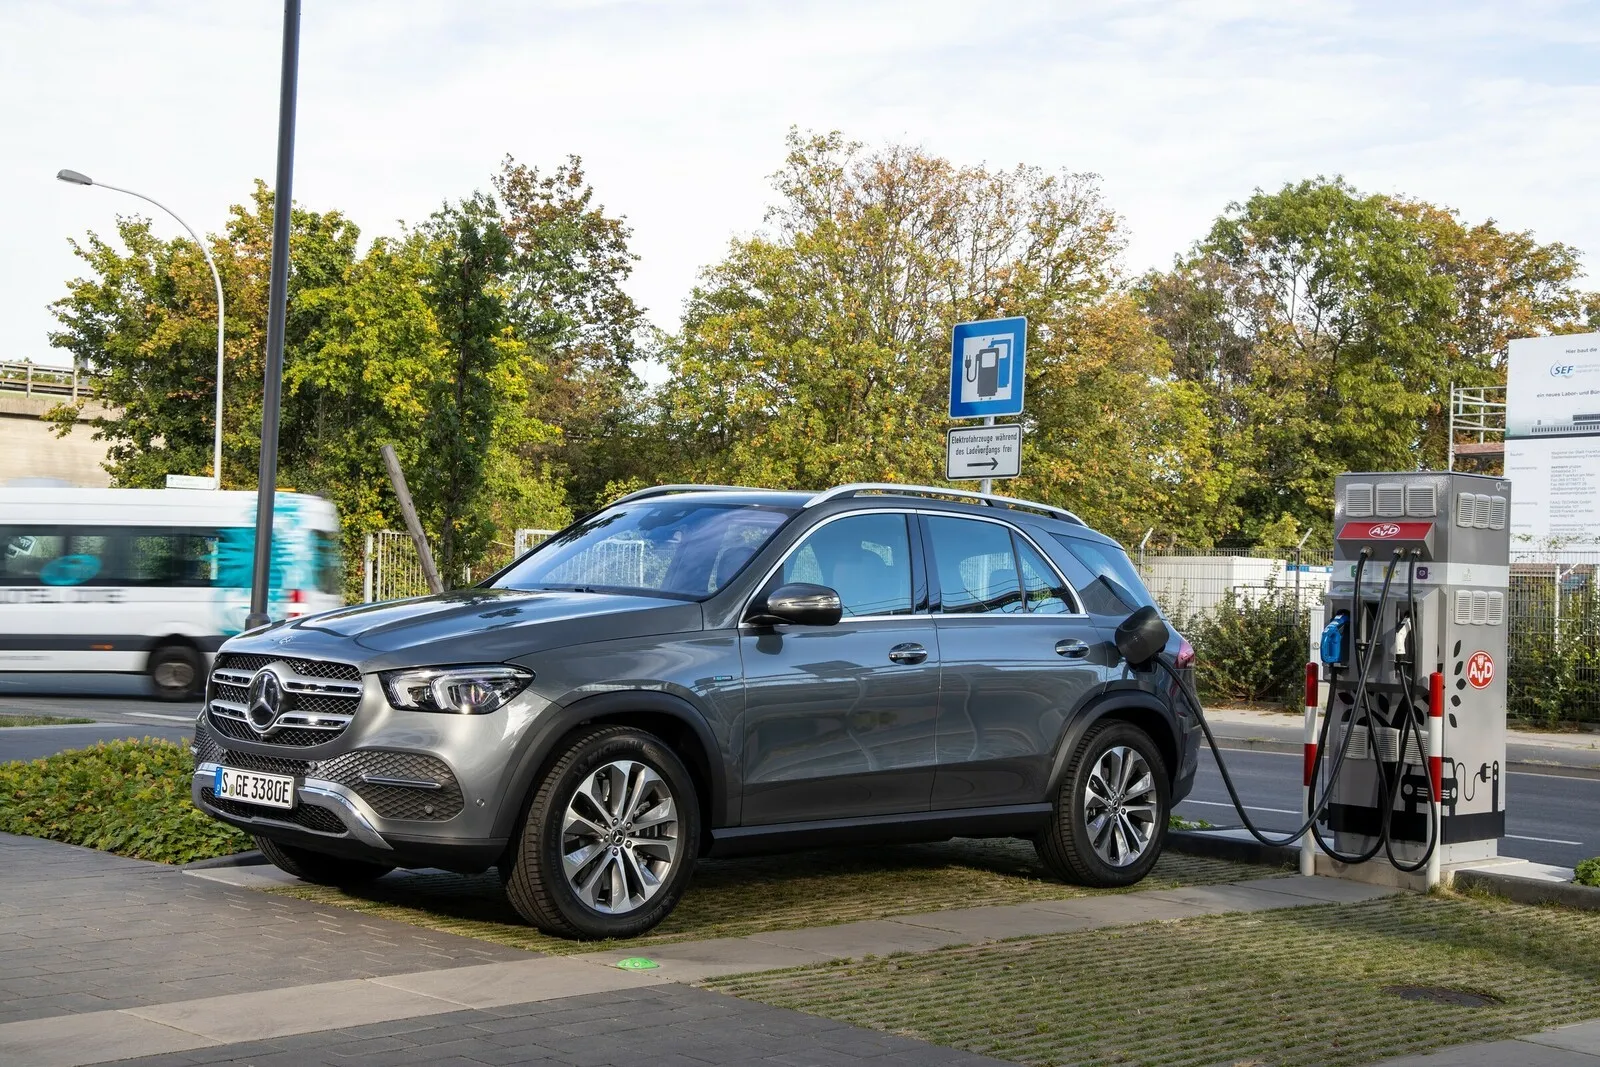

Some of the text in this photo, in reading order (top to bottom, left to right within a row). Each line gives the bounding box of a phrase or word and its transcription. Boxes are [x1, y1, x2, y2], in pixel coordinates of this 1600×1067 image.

[1554, 365, 1574, 375] SEF
[951, 433, 1018, 444] Elektrofahrzeuge während
[966, 446, 1001, 455] Ladevorgangs
[222, 772, 291, 804] S GE 3380E
